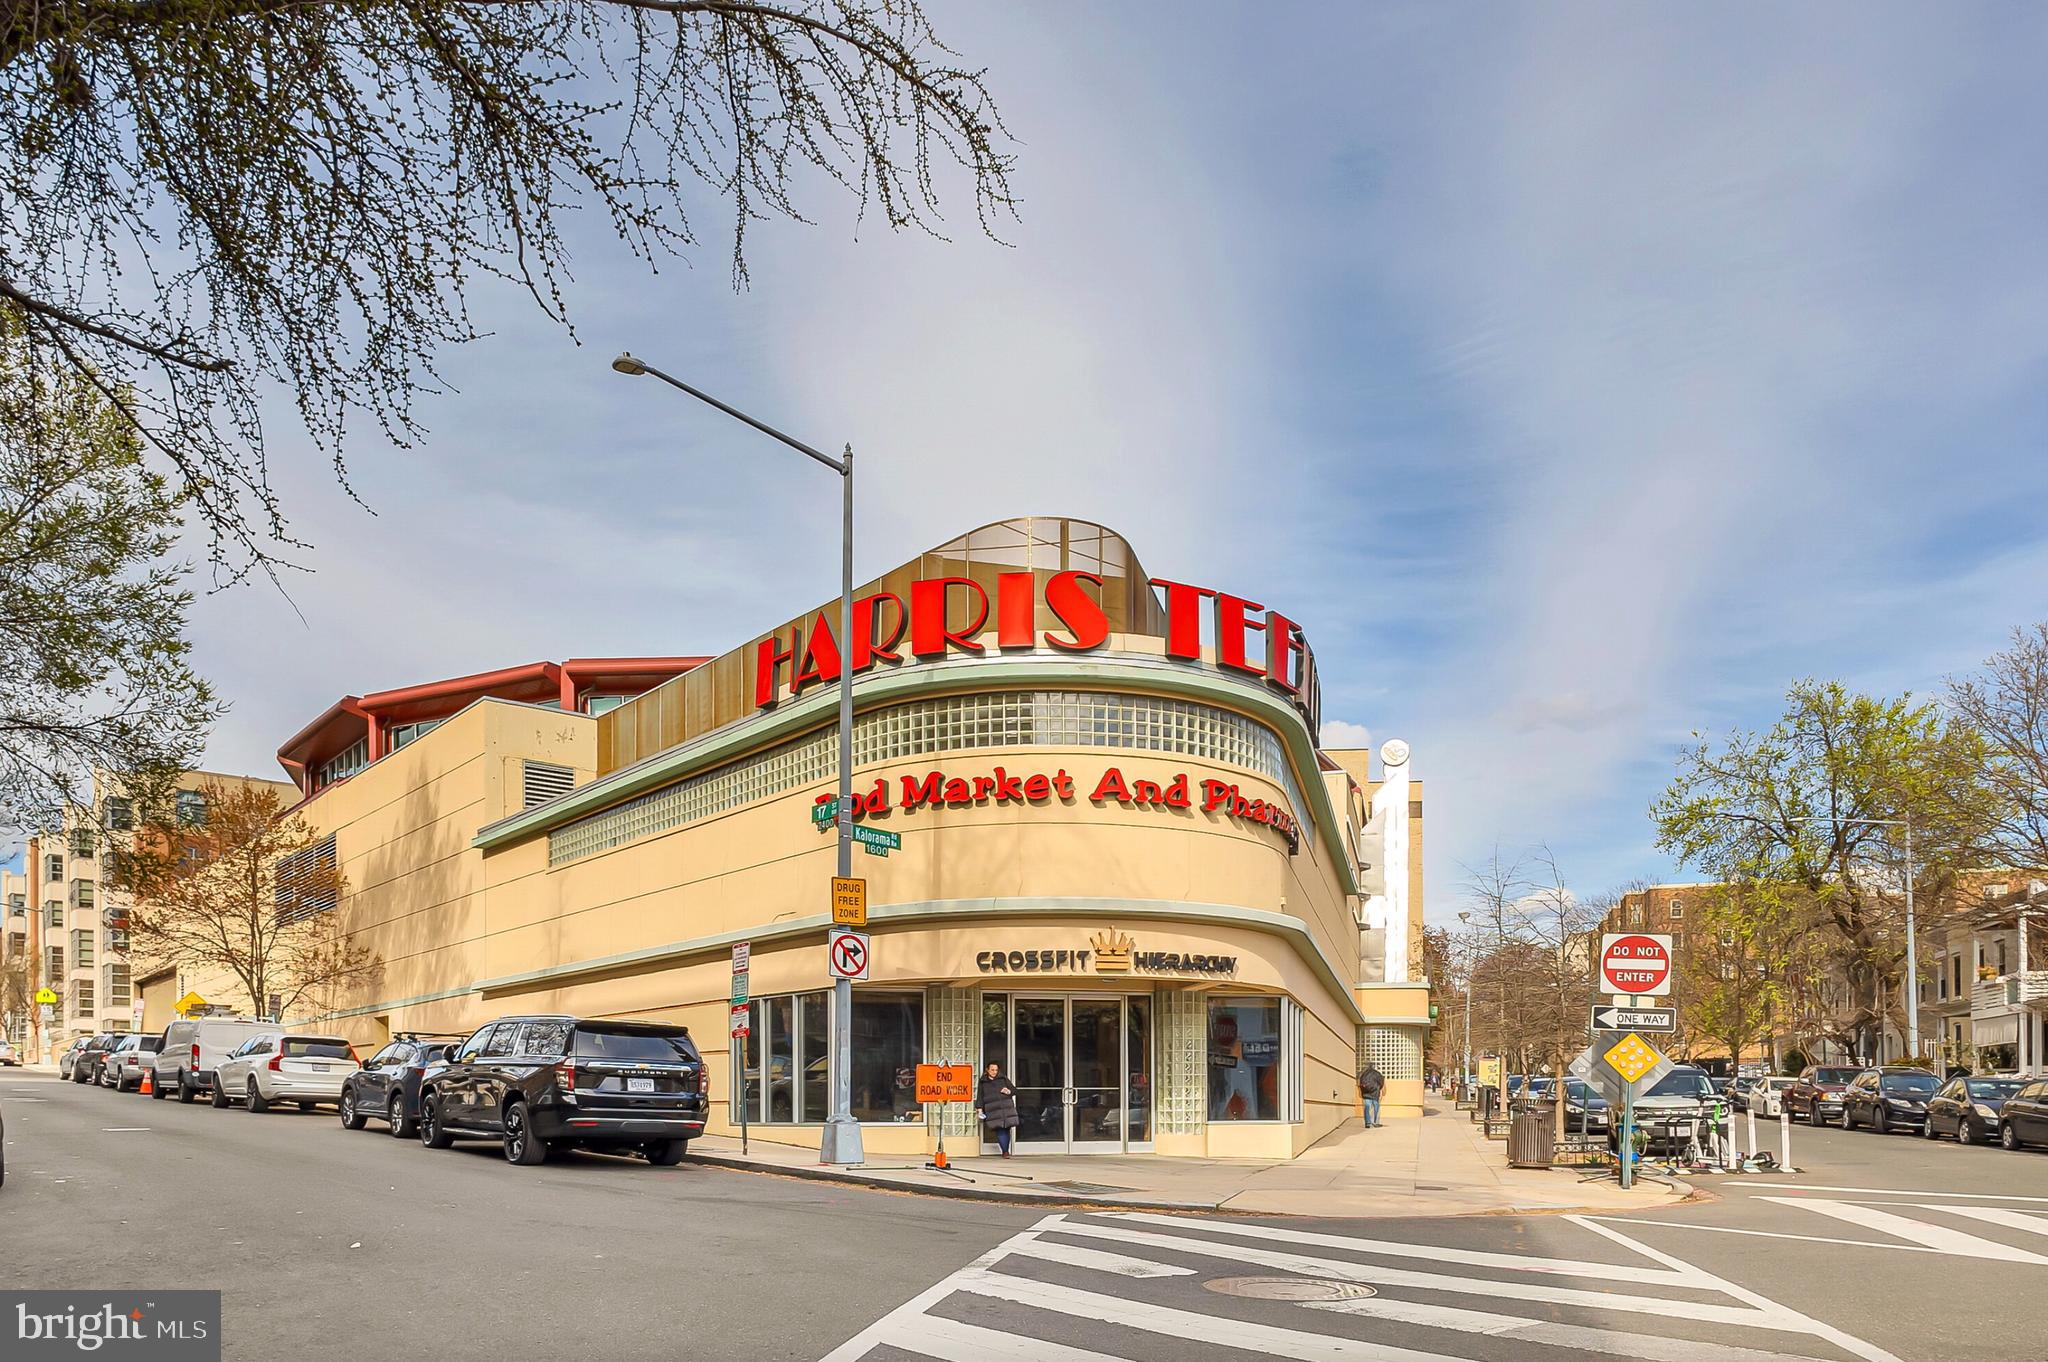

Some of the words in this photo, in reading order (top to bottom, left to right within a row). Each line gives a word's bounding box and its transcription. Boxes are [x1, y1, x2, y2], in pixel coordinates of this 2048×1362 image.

[756, 571, 1111, 708] HARRIS
[900, 767, 1075, 808] Market
[1090, 767, 1192, 808] And
[817, 805, 827, 819] 17
[855, 827, 891, 846] Kalorama
[866, 844, 888, 856] 1600
[837, 883, 861, 893] DRUG
[838, 896, 860, 906] FREE
[839, 909, 859, 918] ZONE
[1613, 946, 1630, 956] DO
[1637, 947, 1660, 956] NOT
[976, 950, 1090, 973] CROSSFIT
[1134, 951, 1237, 974] HIERARCHY
[1616, 972, 1654, 982] ENTER
[1617, 1014, 1638, 1023] ONE
[1643, 1015, 1666, 1024] WAY
[937, 1072, 952, 1081] END
[921, 1085, 941, 1095] ROAD
[946, 1085, 968, 1095] WORK
